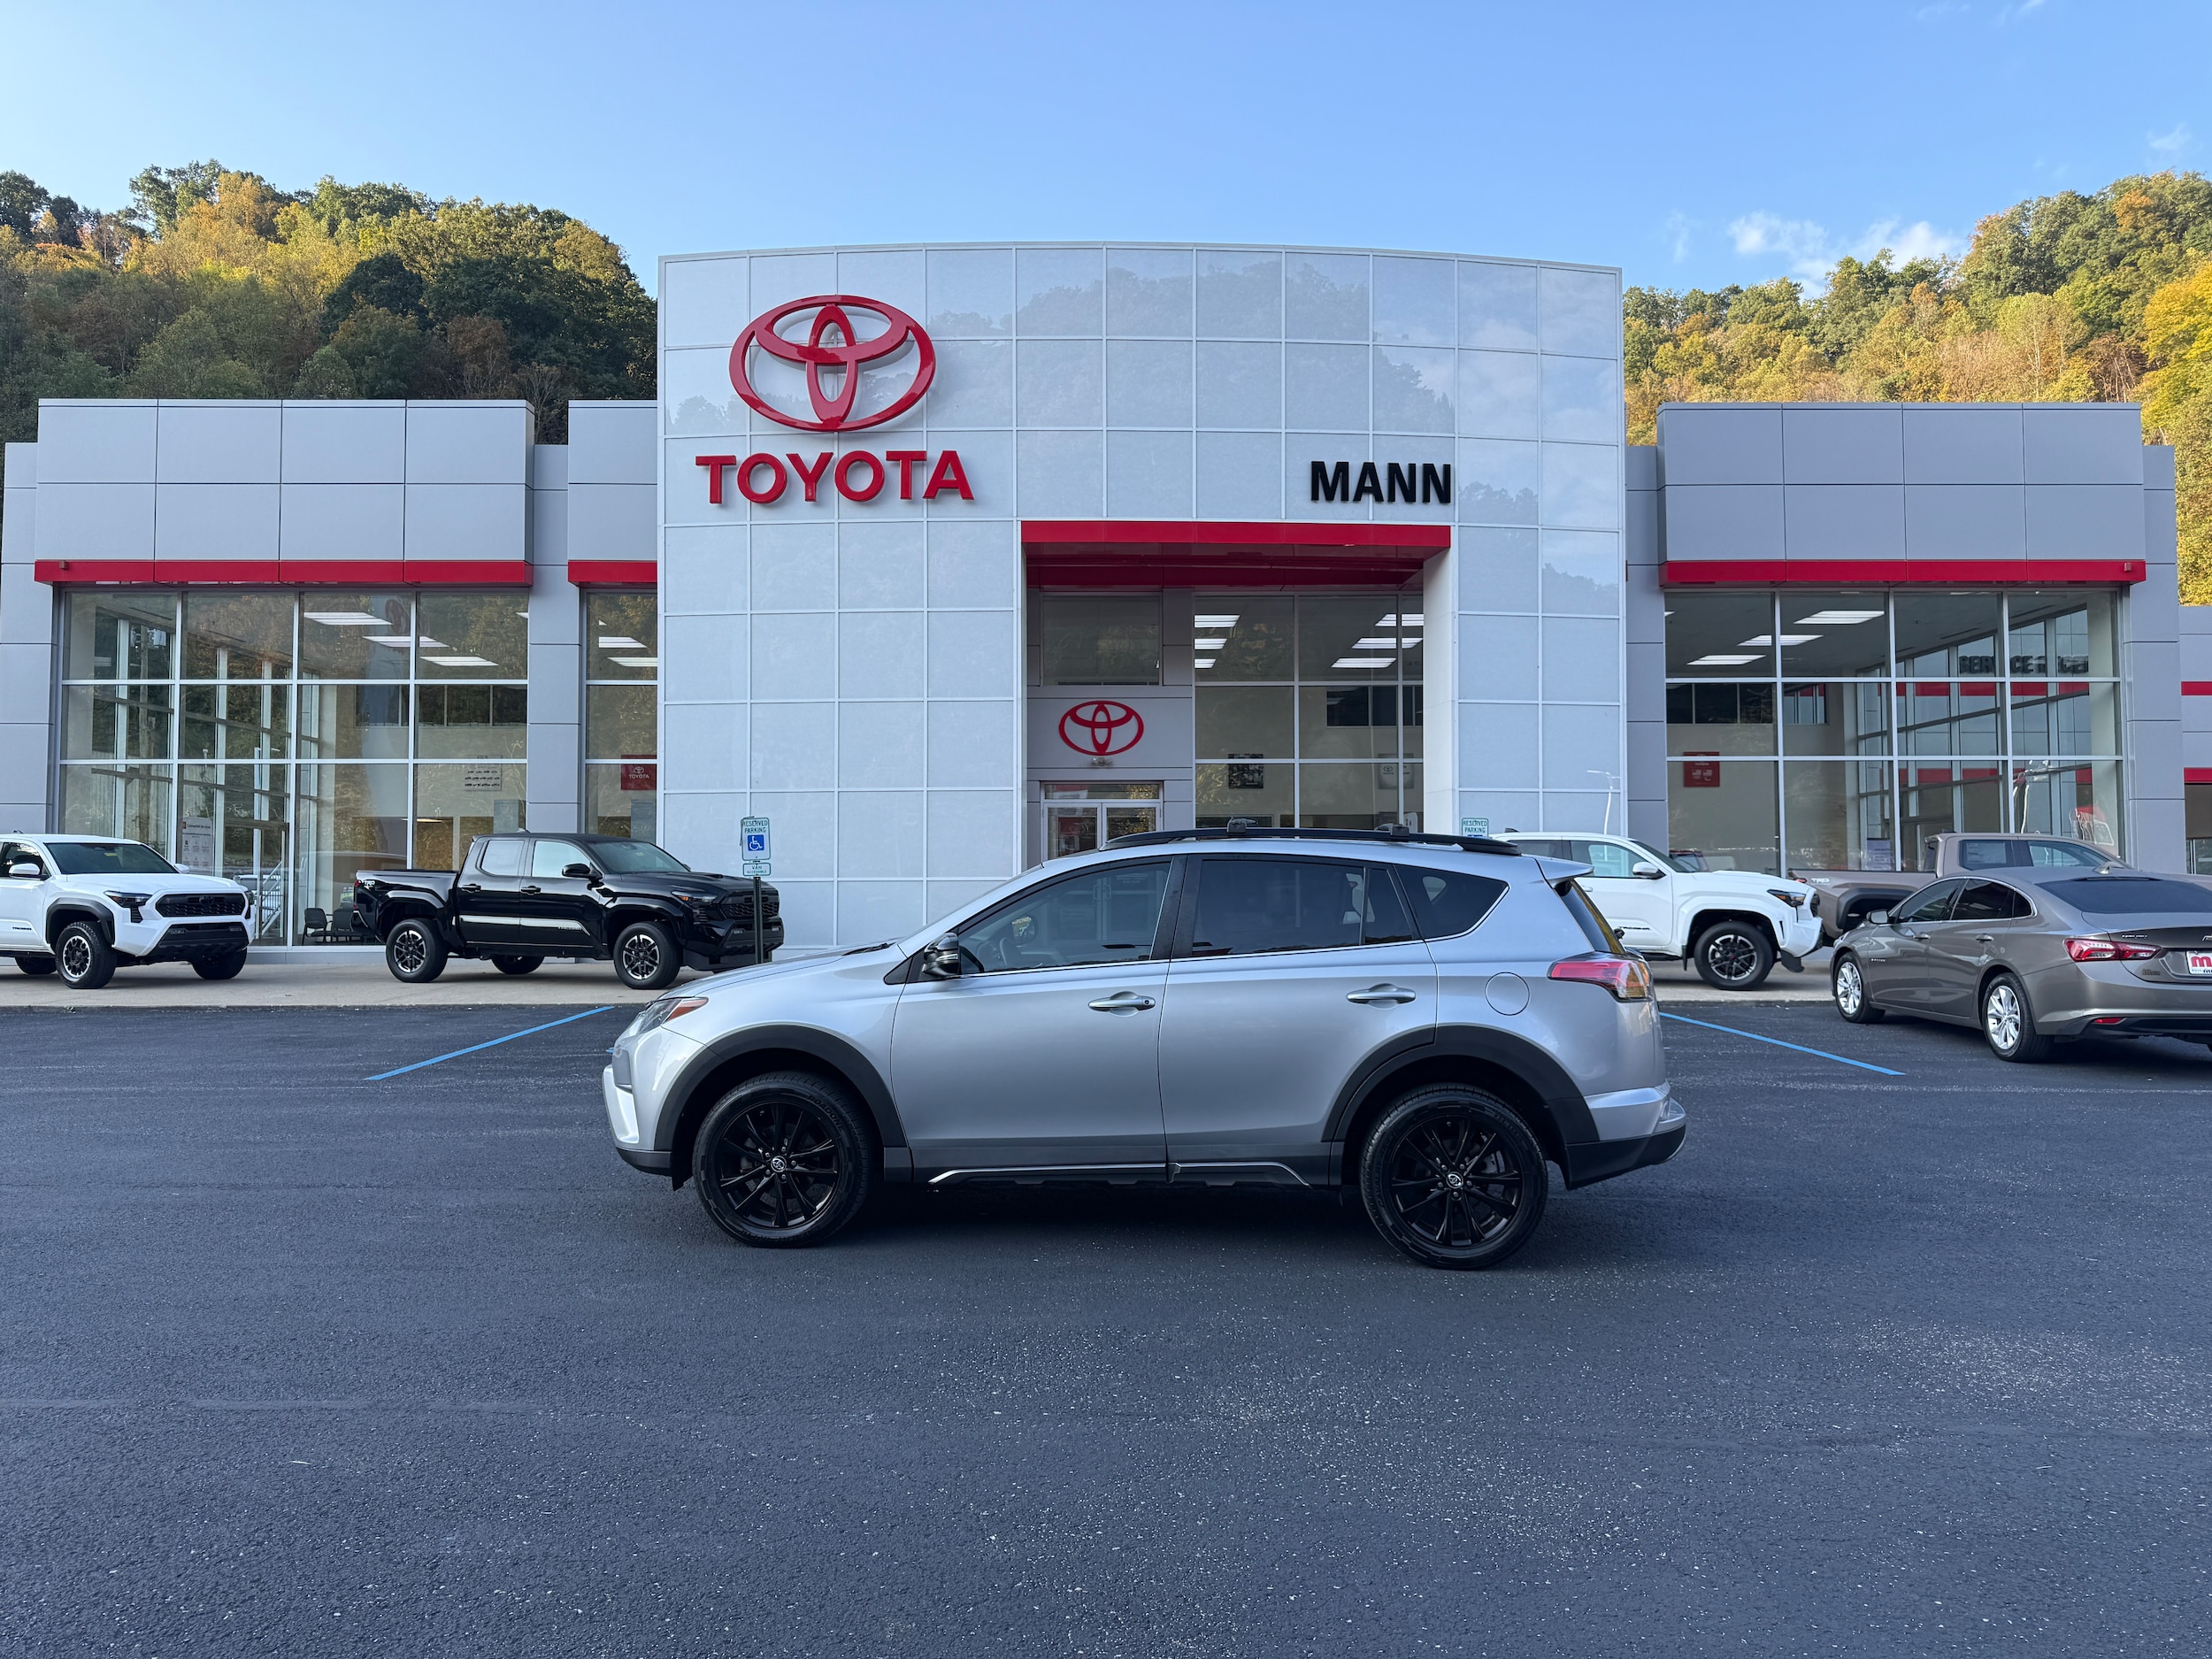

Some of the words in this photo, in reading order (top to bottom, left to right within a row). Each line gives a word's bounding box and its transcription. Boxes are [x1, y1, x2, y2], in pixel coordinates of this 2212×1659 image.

[695, 449, 974, 504] TOYOTA
[1310, 460, 1451, 503] MANN
[1959, 655, 2034, 673] SERCE
[806, 1094, 844, 1133] ROADONE
